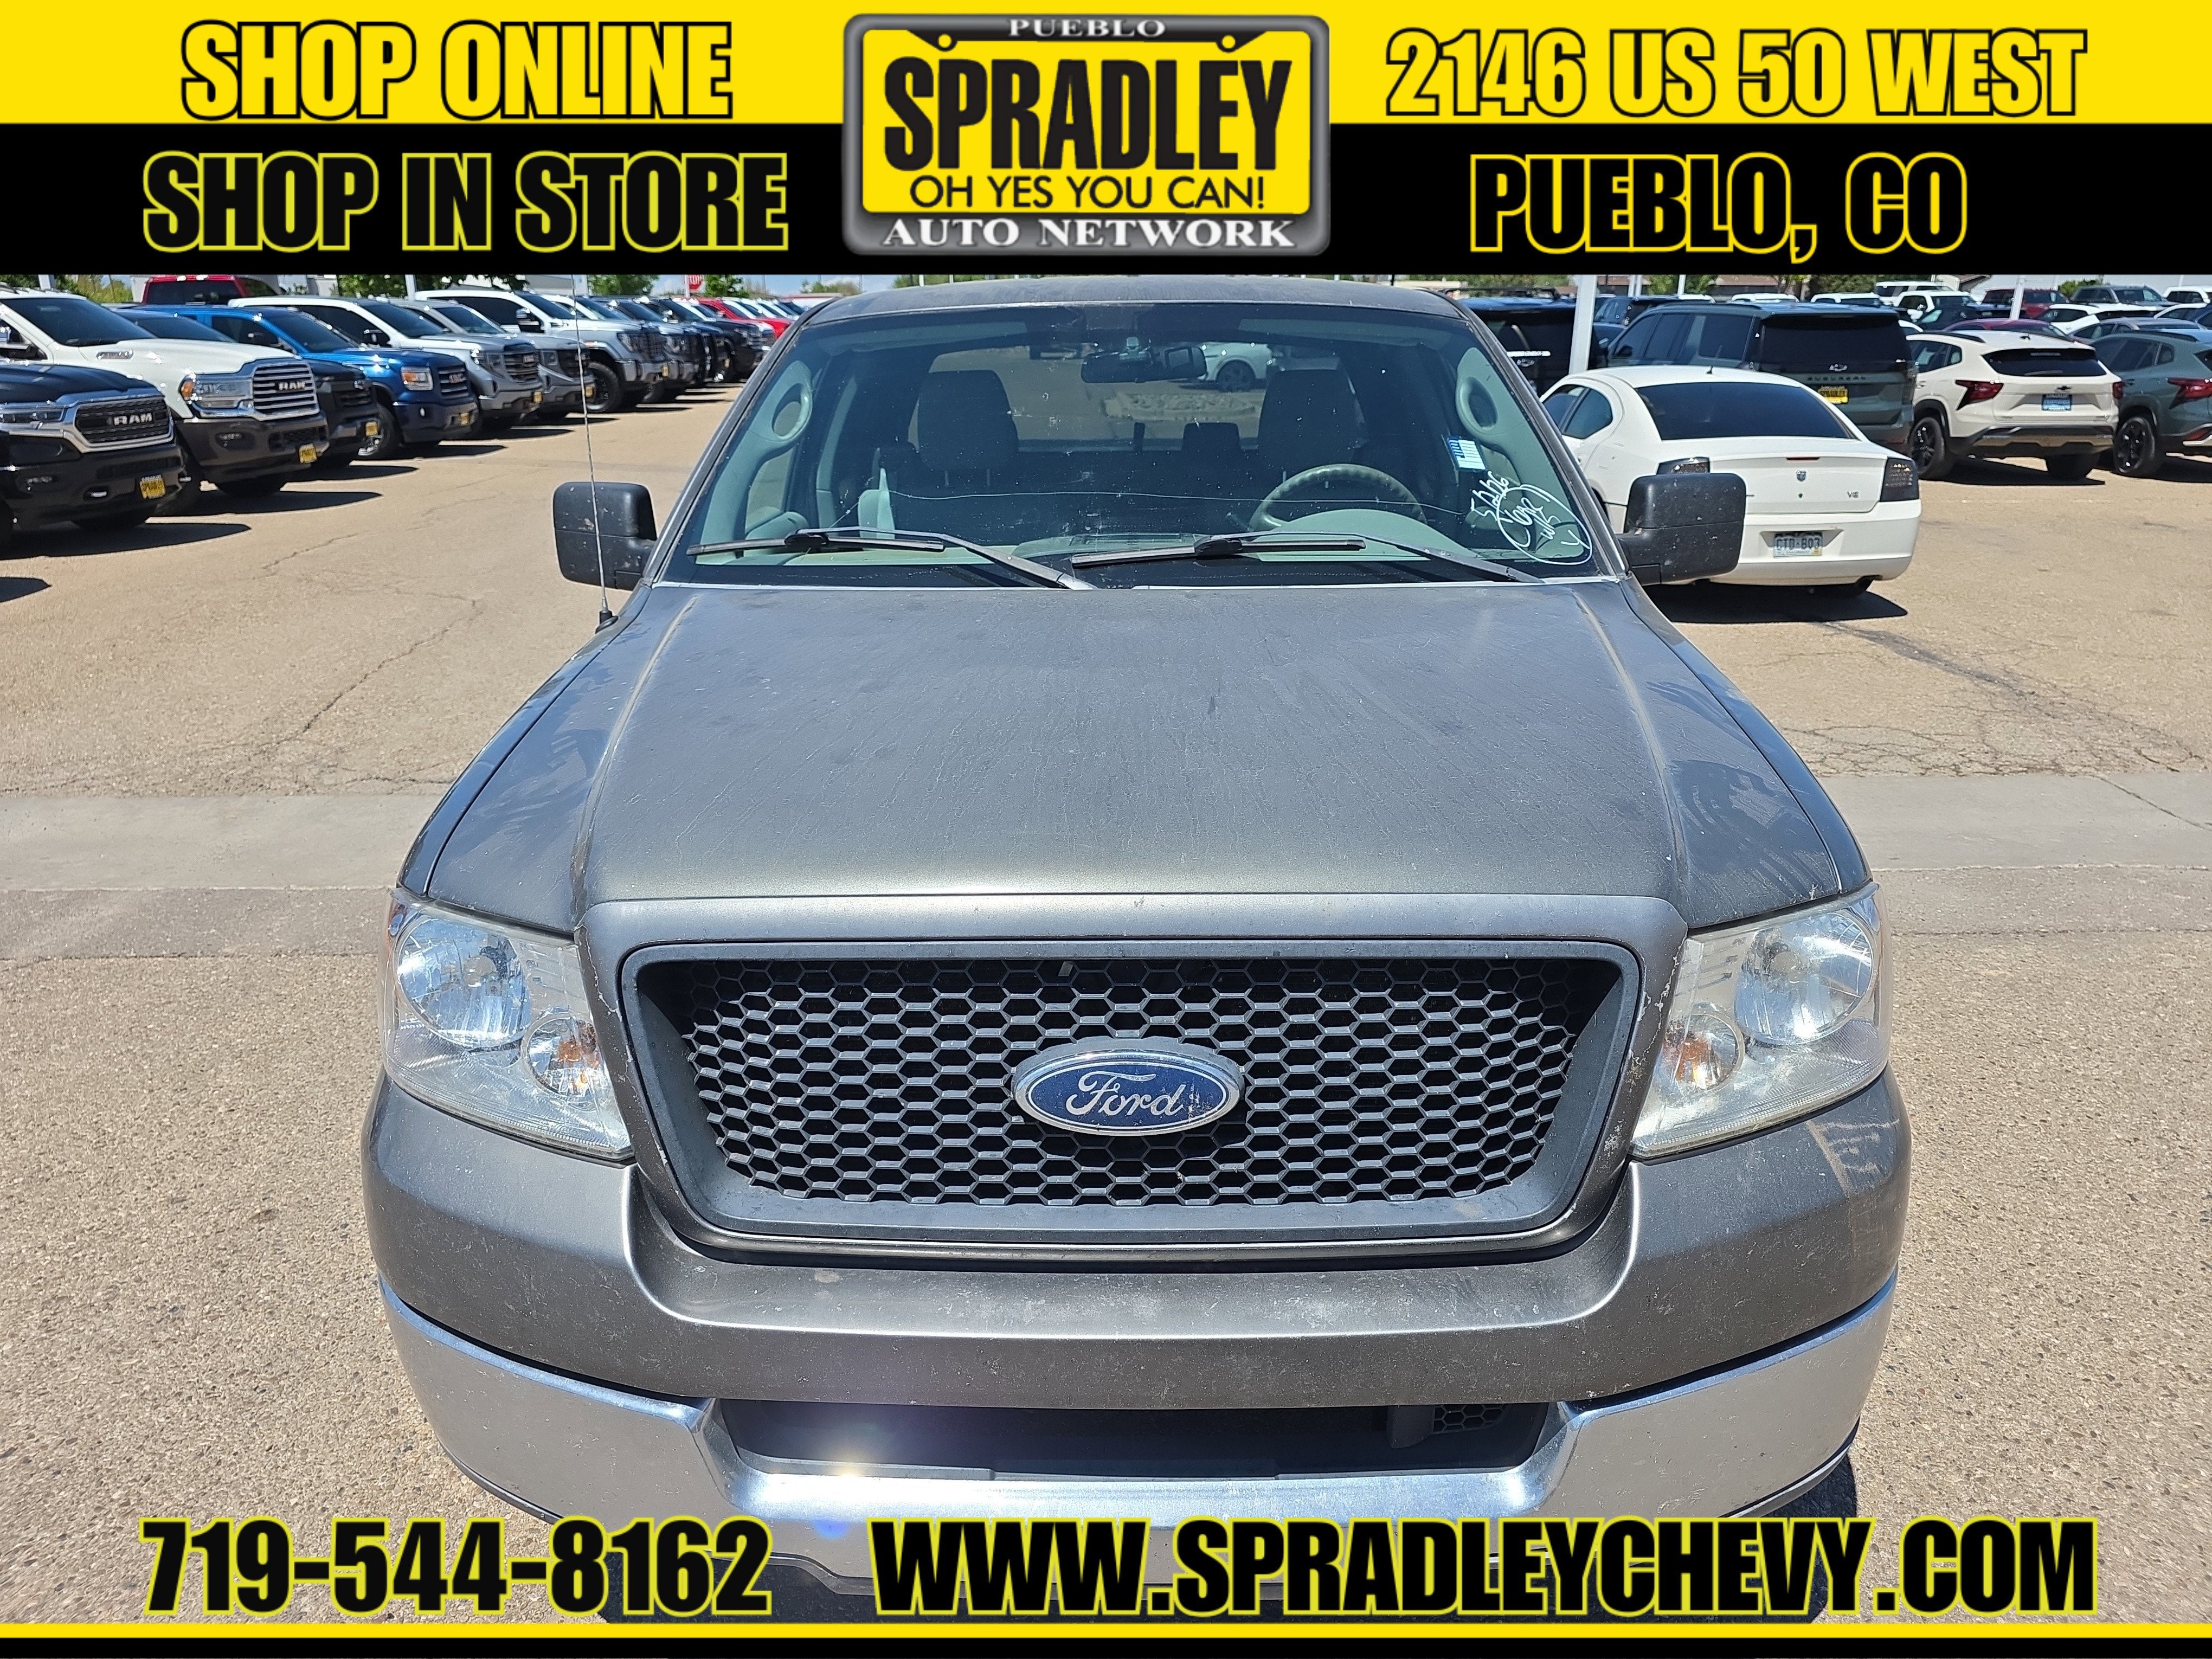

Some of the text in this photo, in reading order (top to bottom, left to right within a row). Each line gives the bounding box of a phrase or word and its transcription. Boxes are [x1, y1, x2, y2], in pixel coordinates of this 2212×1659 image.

[278, 381, 306, 391] RAM
[113, 412, 153, 426] RAM
[1065, 1070, 1186, 1116] Ford
